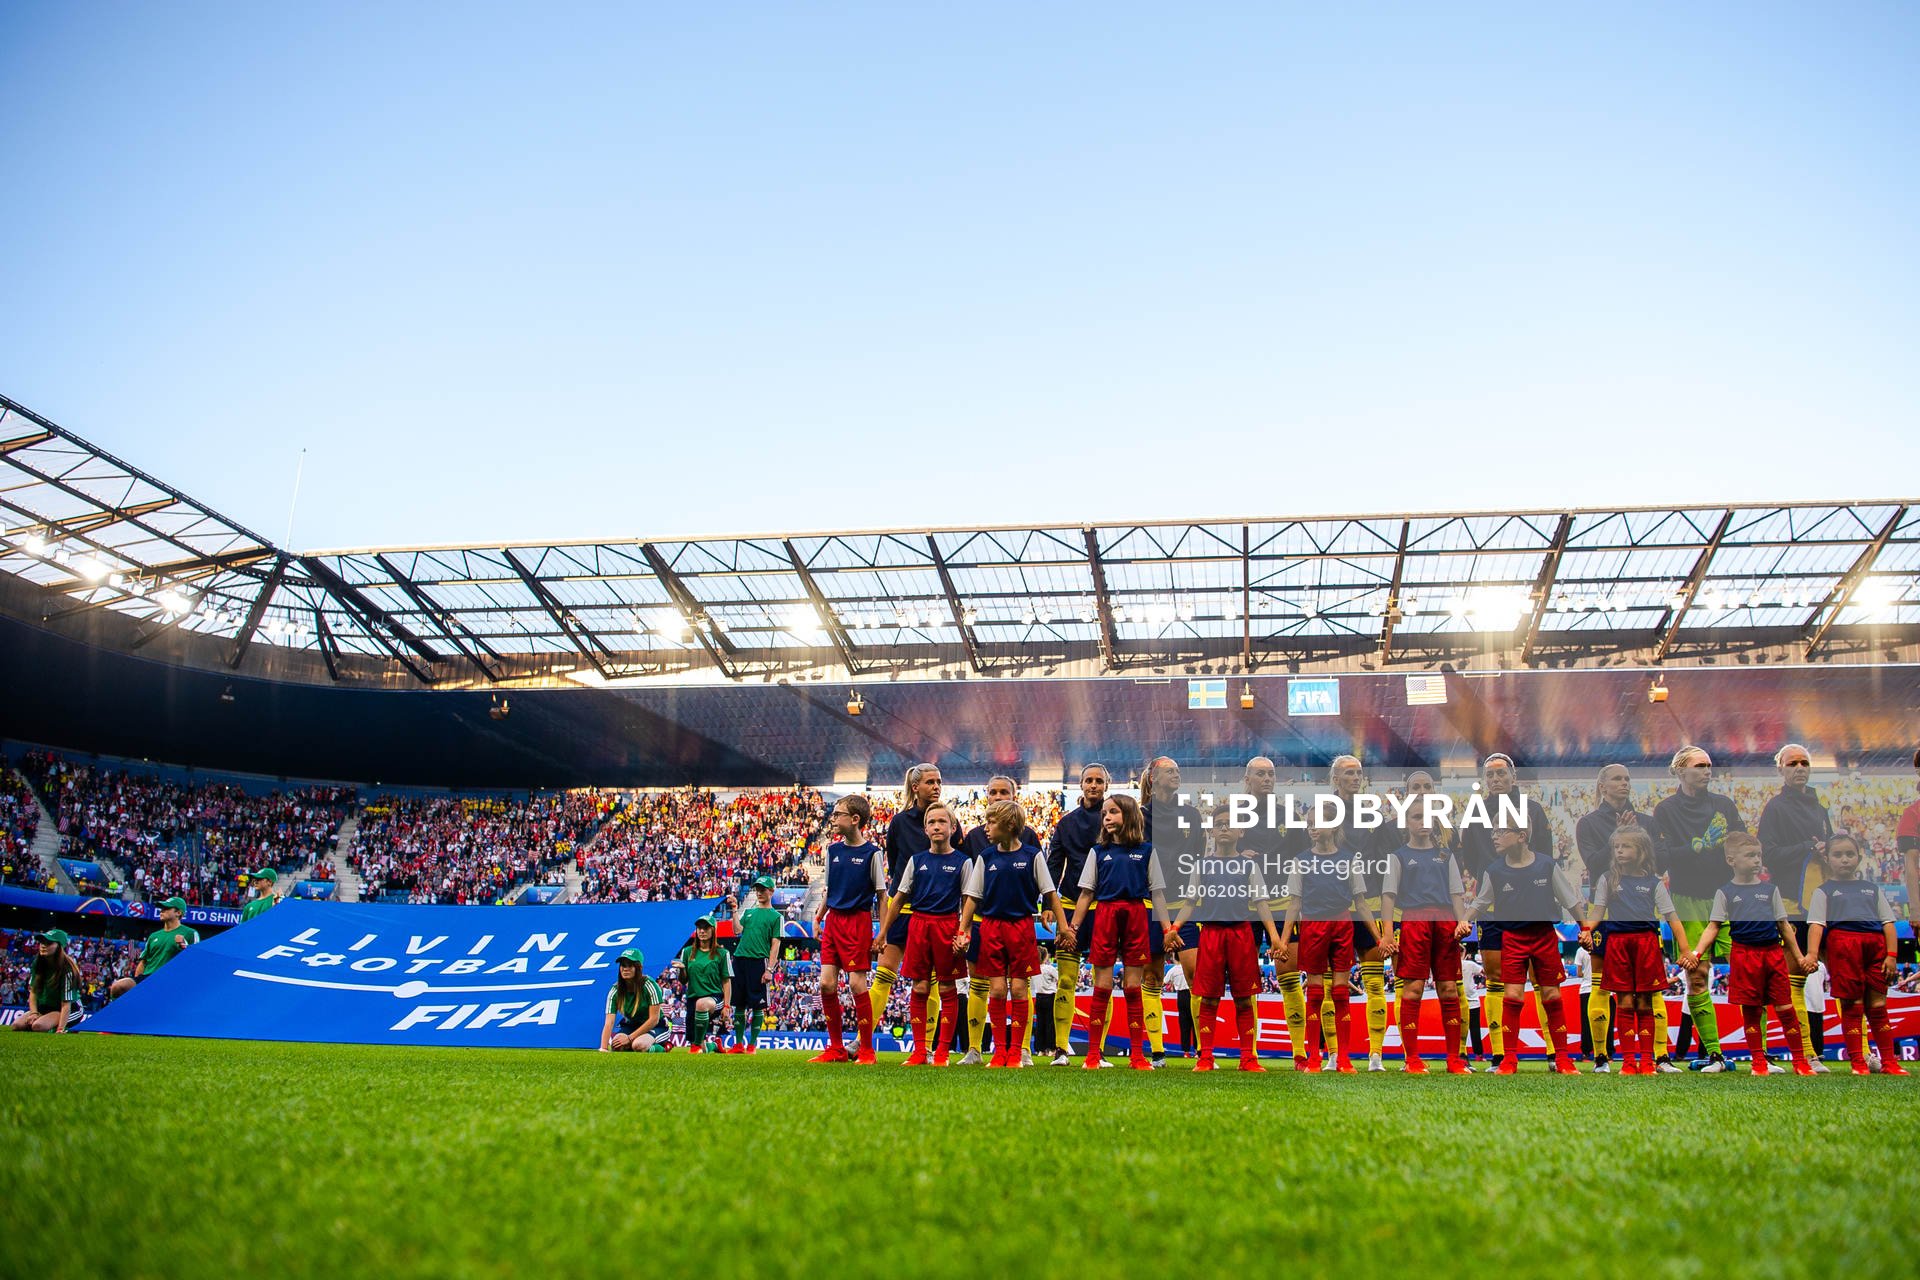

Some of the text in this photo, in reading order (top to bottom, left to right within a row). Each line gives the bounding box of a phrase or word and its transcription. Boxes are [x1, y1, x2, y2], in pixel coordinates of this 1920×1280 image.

[1295, 690, 1332, 705] FIFA
[190, 910, 207, 921] TO
[209, 912, 243, 924] SHIN
[289, 927, 641, 955] LIVING
[388, 998, 561, 1031] FIFA
